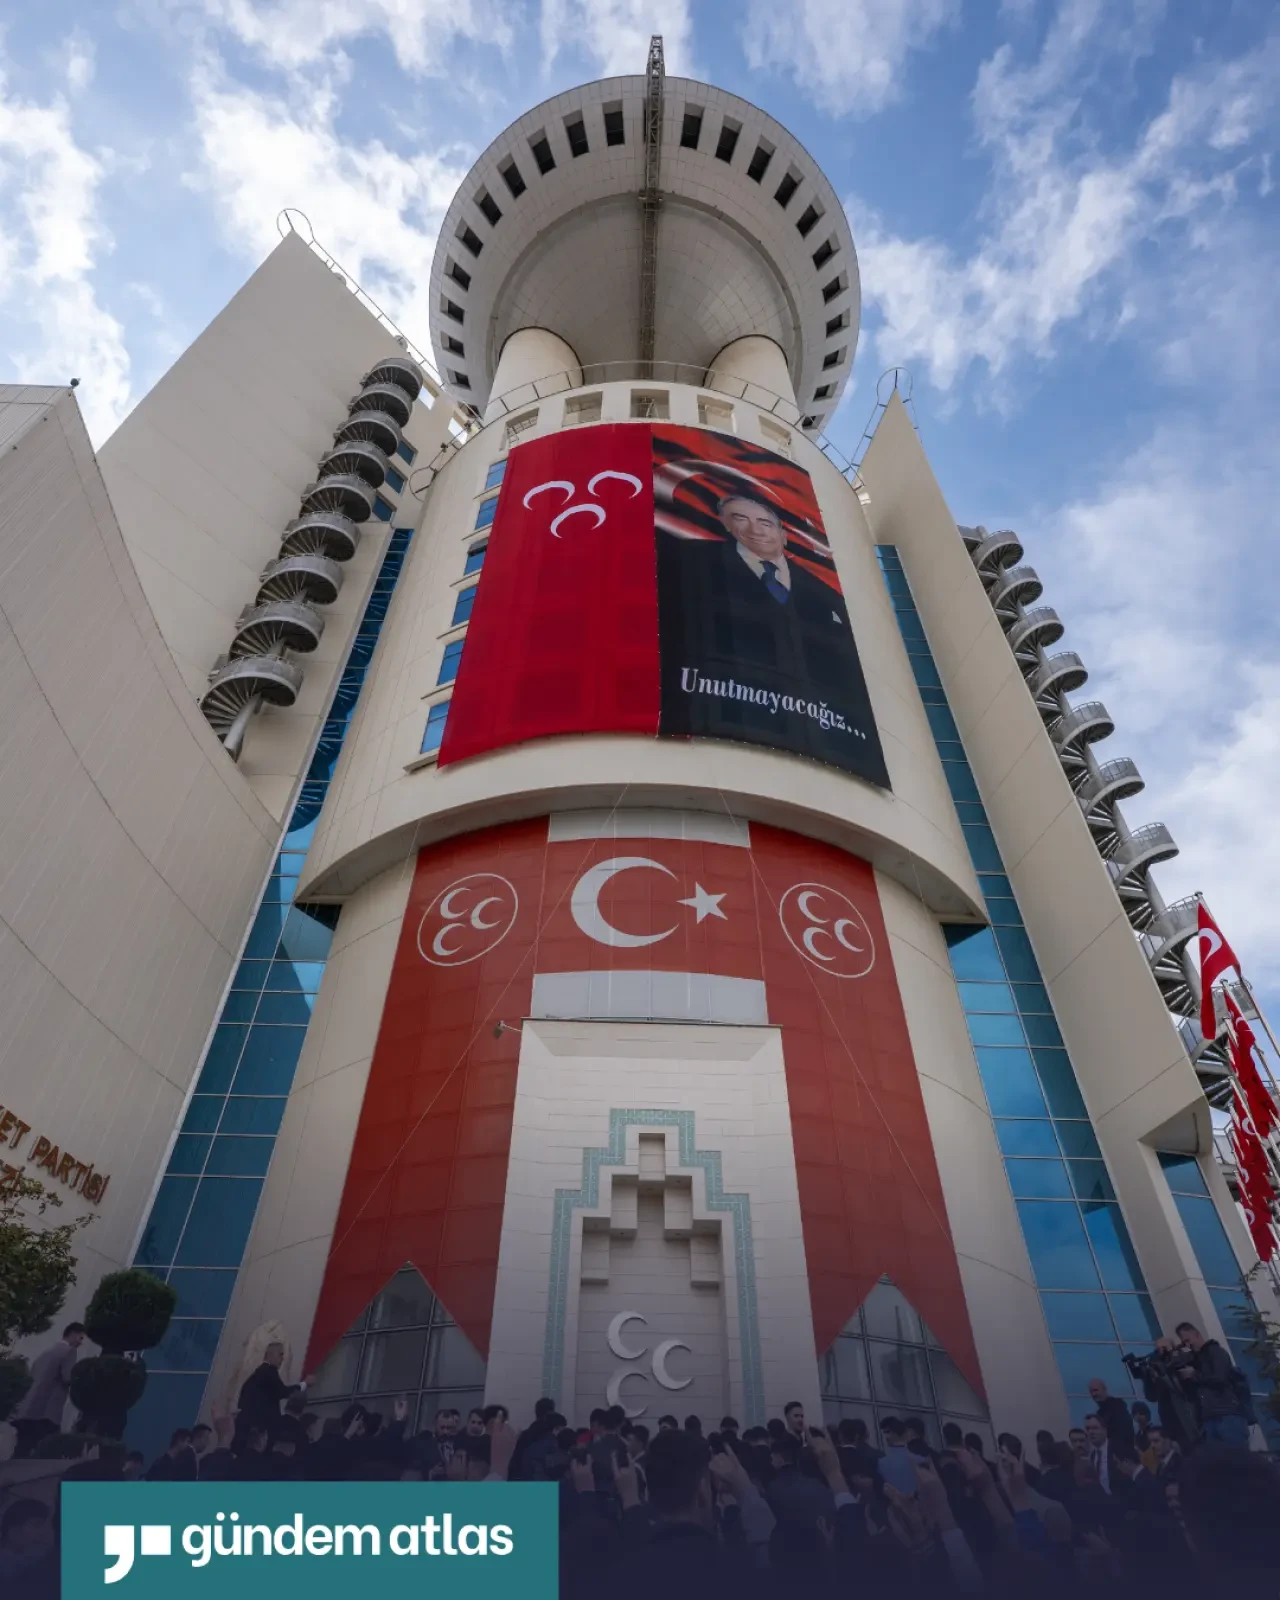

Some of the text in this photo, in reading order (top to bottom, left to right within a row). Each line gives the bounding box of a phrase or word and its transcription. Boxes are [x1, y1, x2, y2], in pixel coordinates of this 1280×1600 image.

[681, 667, 867, 740] Unutmayacağız...
[0, 1105, 111, 1205] ET PARTİSİ
